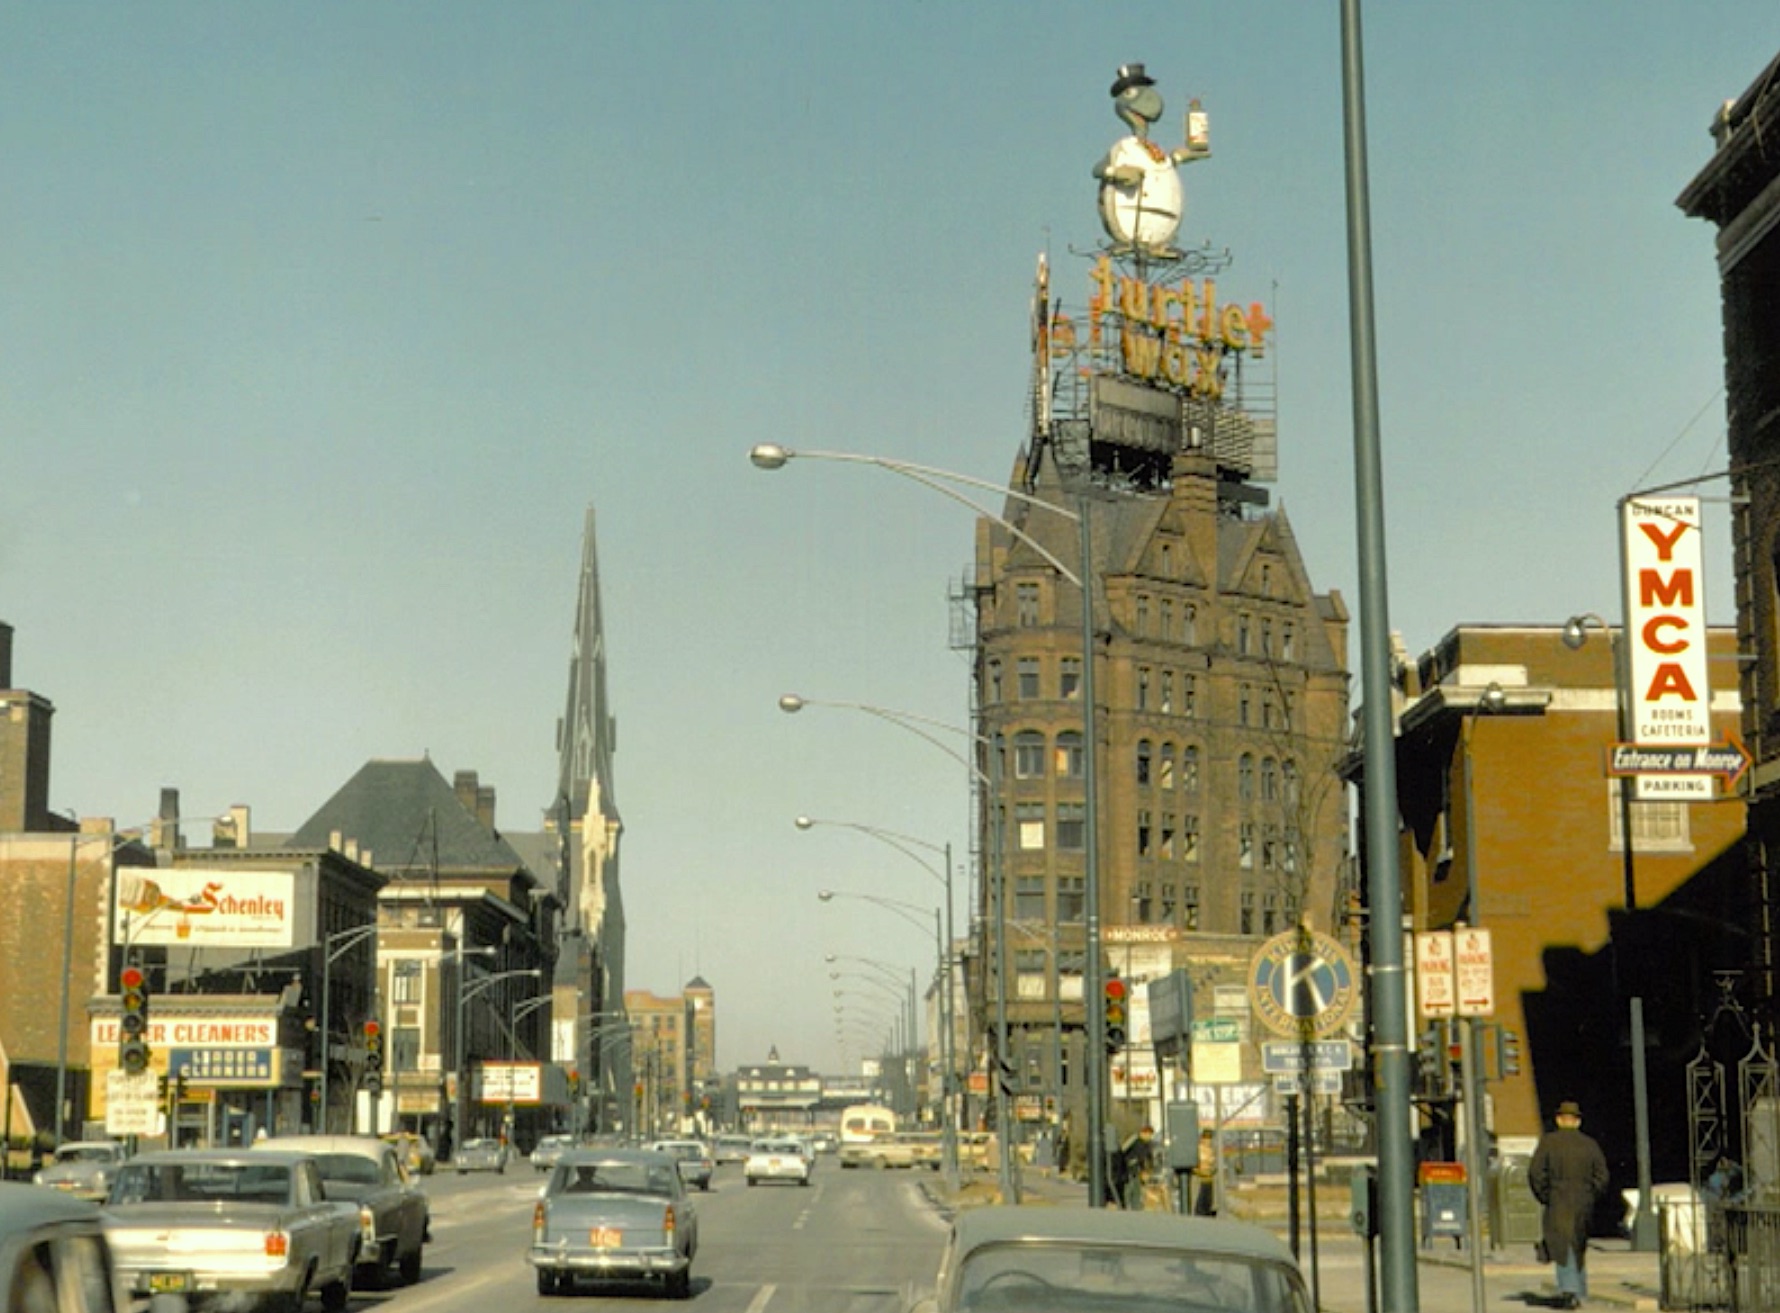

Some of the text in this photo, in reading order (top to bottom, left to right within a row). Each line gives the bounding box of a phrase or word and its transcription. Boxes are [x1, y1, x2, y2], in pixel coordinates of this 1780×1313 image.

[1089, 254, 1247, 350] turtle
[1122, 326, 1224, 401] wax
[1638, 521, 1698, 701] YMCA
[1651, 708, 1693, 721] ROOMS
[1641, 724, 1706, 737] CAFETERIA
[1613, 746, 1744, 770] Entrance on Monroe
[1643, 779, 1705, 792] PARKING
[202, 881, 284, 921] Schenley
[98, 1024, 270, 1042] LEER CLEANERS
